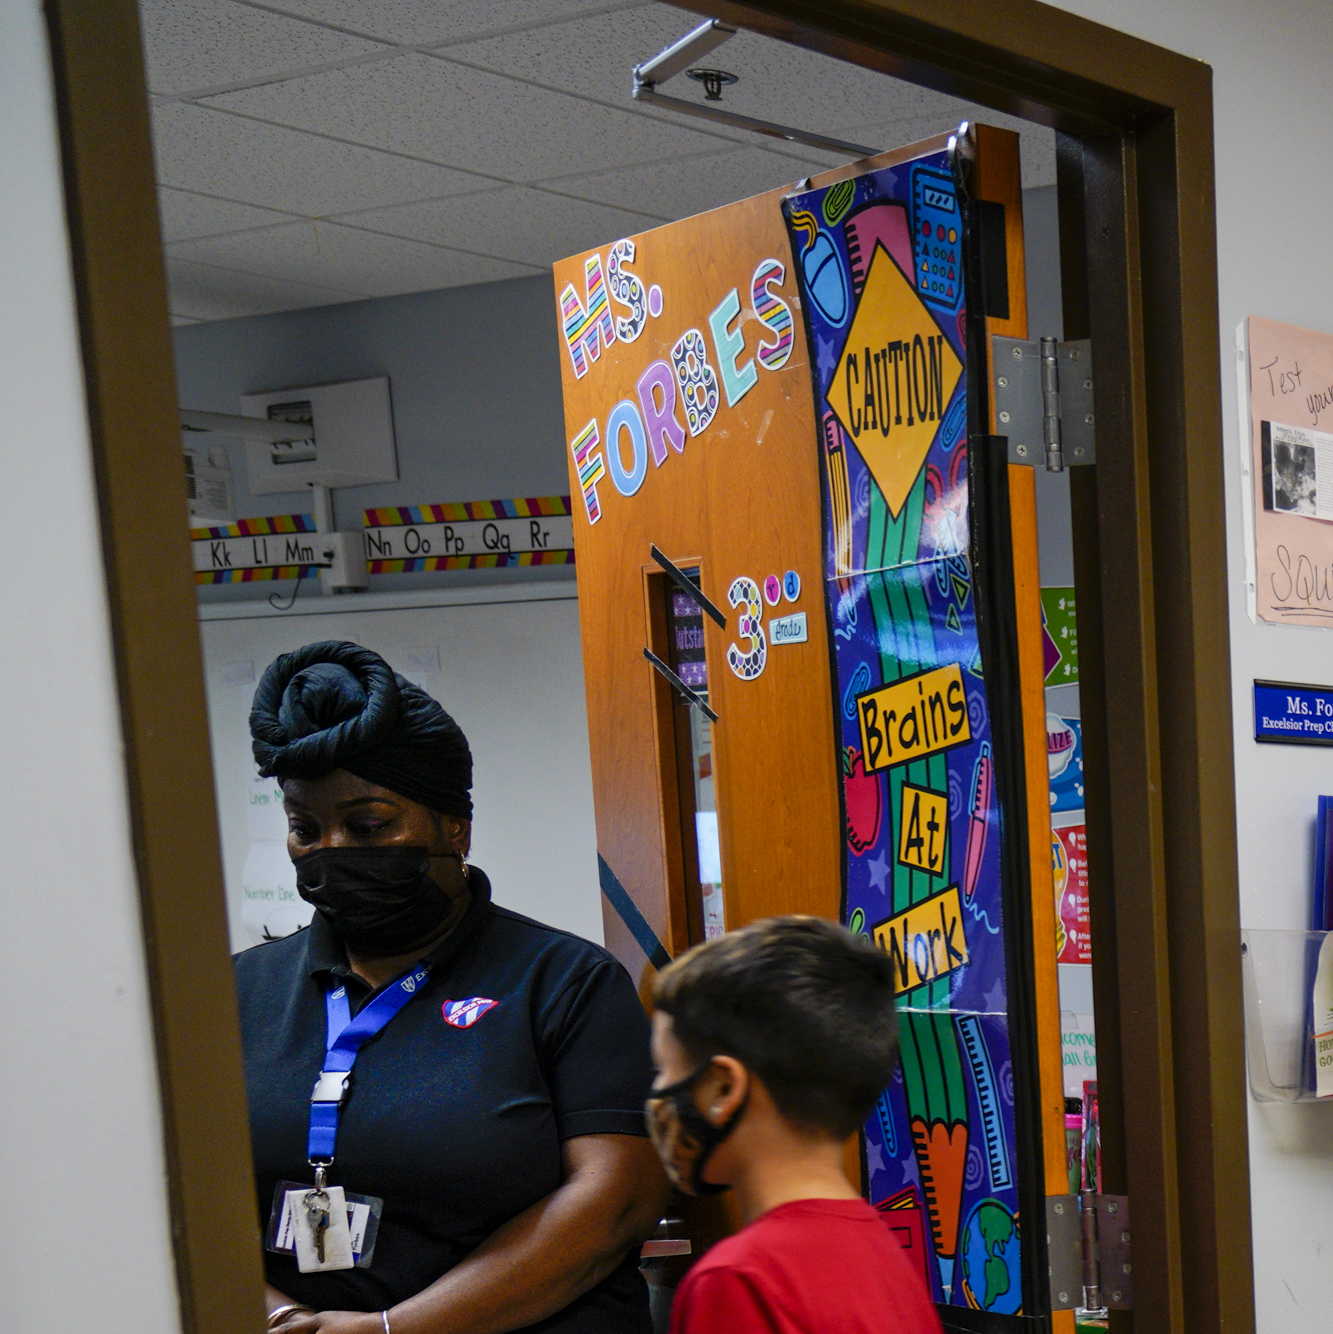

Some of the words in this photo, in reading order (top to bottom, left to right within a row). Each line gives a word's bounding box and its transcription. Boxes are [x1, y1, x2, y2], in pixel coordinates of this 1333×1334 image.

[560, 239, 663, 380] MS.
[571, 258, 795, 525] FORBES
[846, 333, 944, 438] CAUTION
[1259, 357, 1302, 396] Test
[1306, 384, 1333, 426] your
[210, 542, 232, 567] Kk
[285, 537, 314, 562] Mm
[367, 531, 393, 557] Nn
[404, 528, 431, 554] Oo
[444, 526, 465, 556] Pp
[482, 524, 512, 559] Qq
[530, 521, 550, 548] Rr
[862, 680, 968, 768] Brains
[1262, 716, 1303, 731] Excelsior
[1304, 719, 1324, 734] Prep
[1286, 696, 1313, 715] Ms.
[905, 792, 941, 872] At
[879, 901, 964, 990] Work
